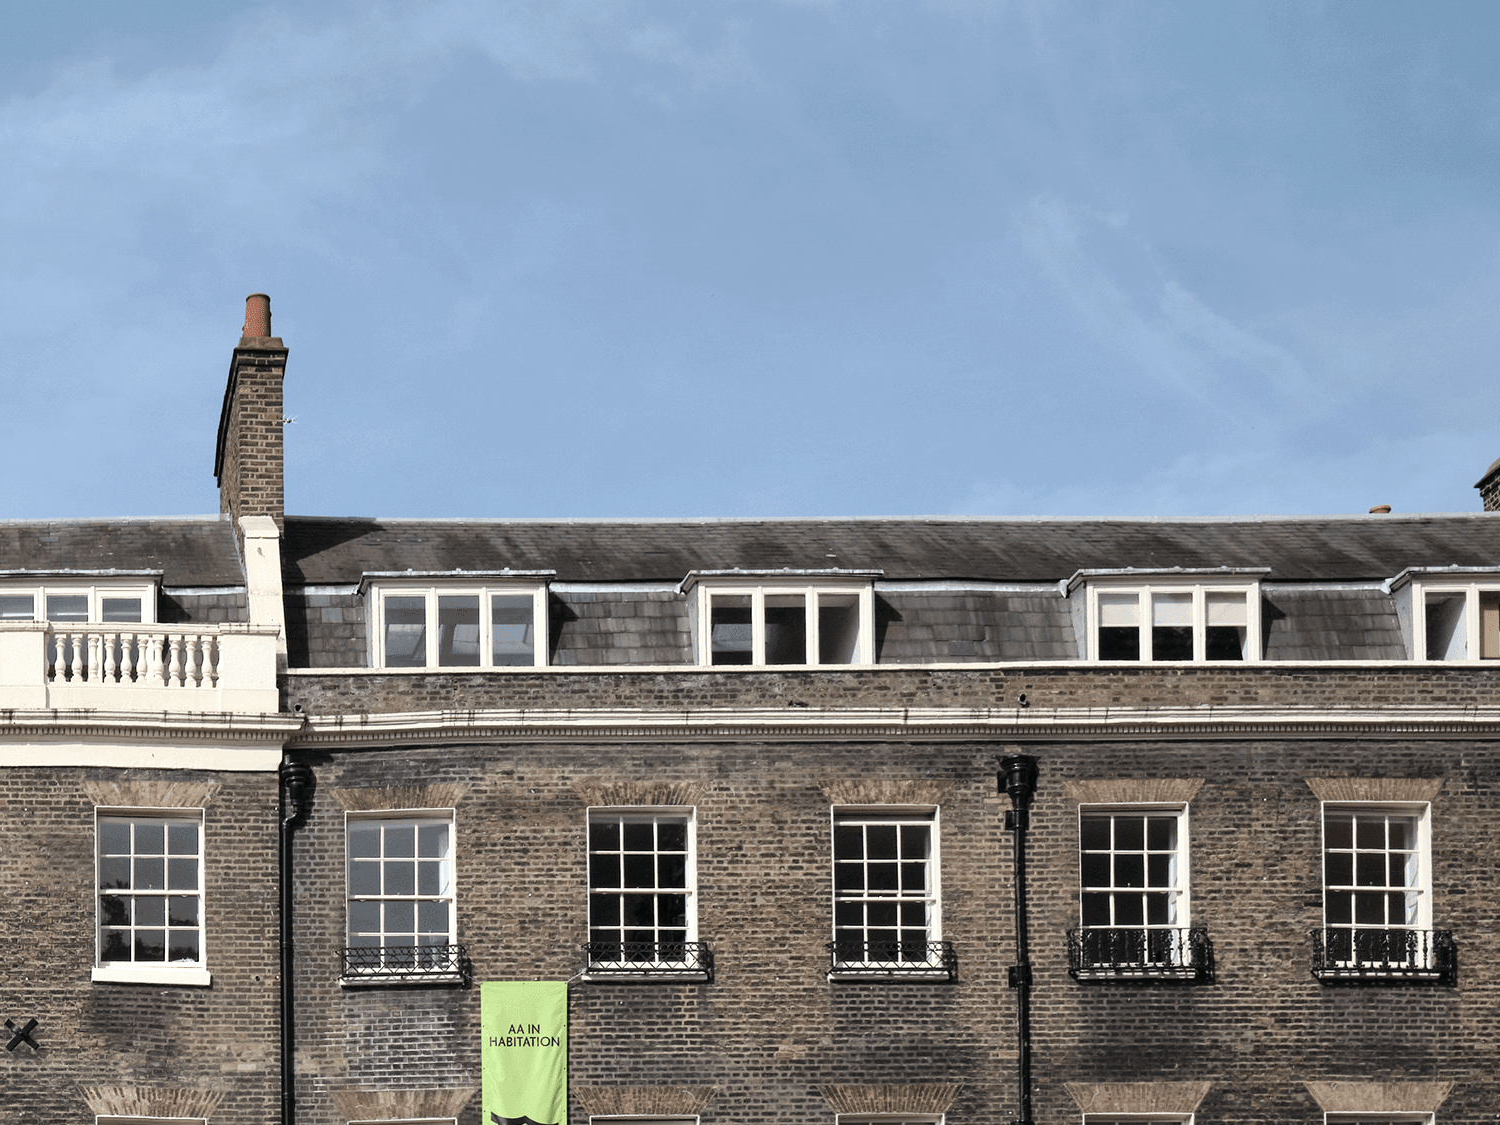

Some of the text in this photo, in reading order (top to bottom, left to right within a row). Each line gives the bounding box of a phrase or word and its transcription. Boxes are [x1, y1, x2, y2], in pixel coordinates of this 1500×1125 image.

[508, 1024, 540, 1034] AA IN
[489, 1036, 560, 1047] HABITATION
